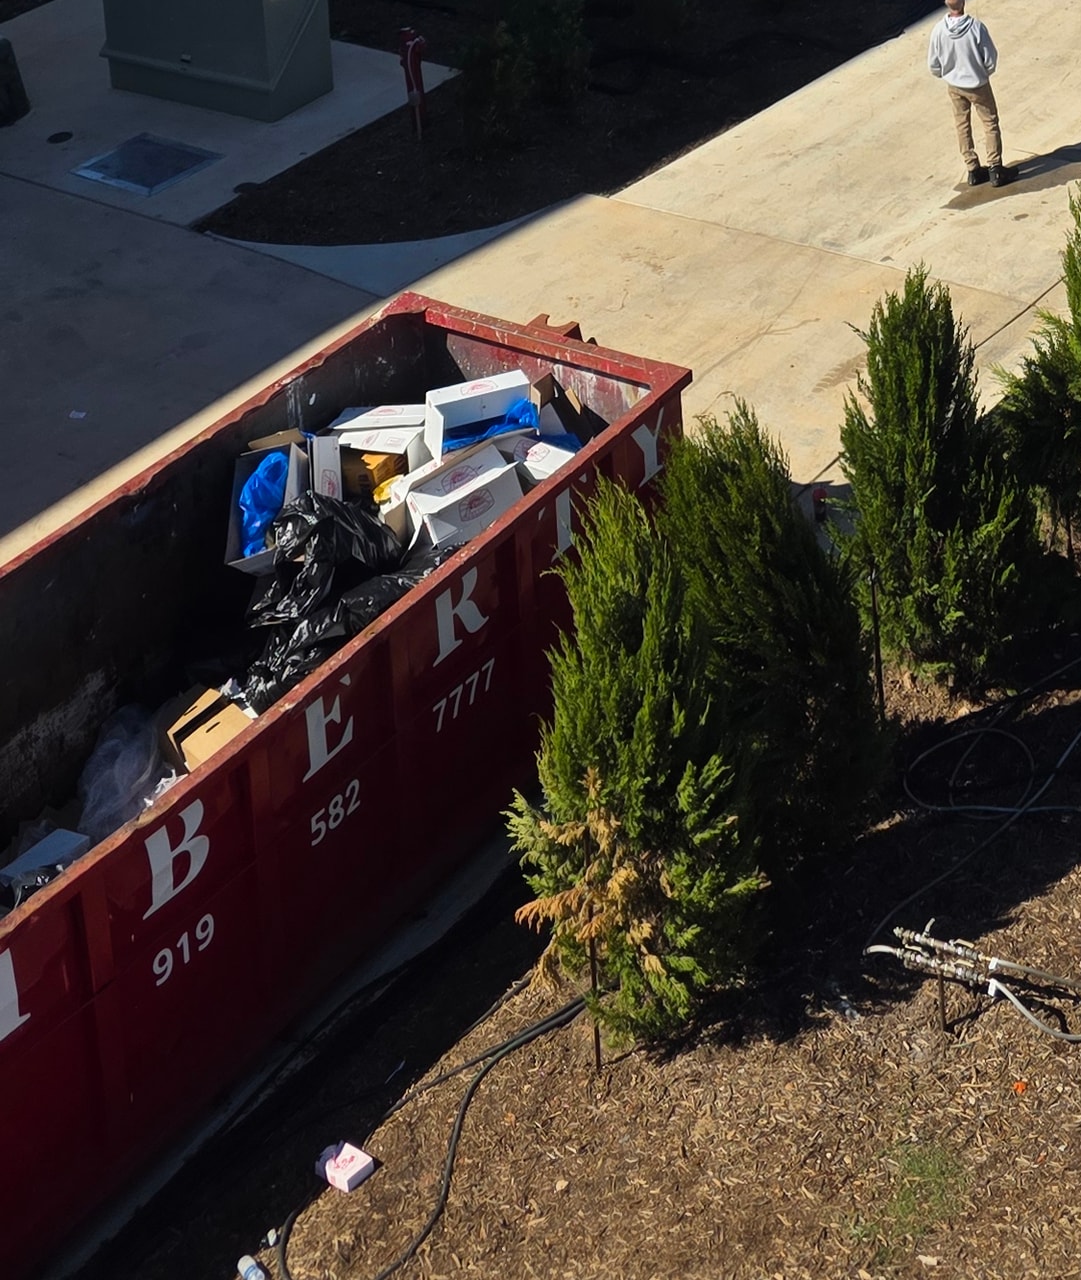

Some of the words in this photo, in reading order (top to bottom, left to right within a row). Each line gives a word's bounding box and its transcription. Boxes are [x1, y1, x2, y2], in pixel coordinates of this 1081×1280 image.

[153, 913, 215, 986] 919
[311, 778, 361, 846] 582
[432, 658, 496, 733] 7777
